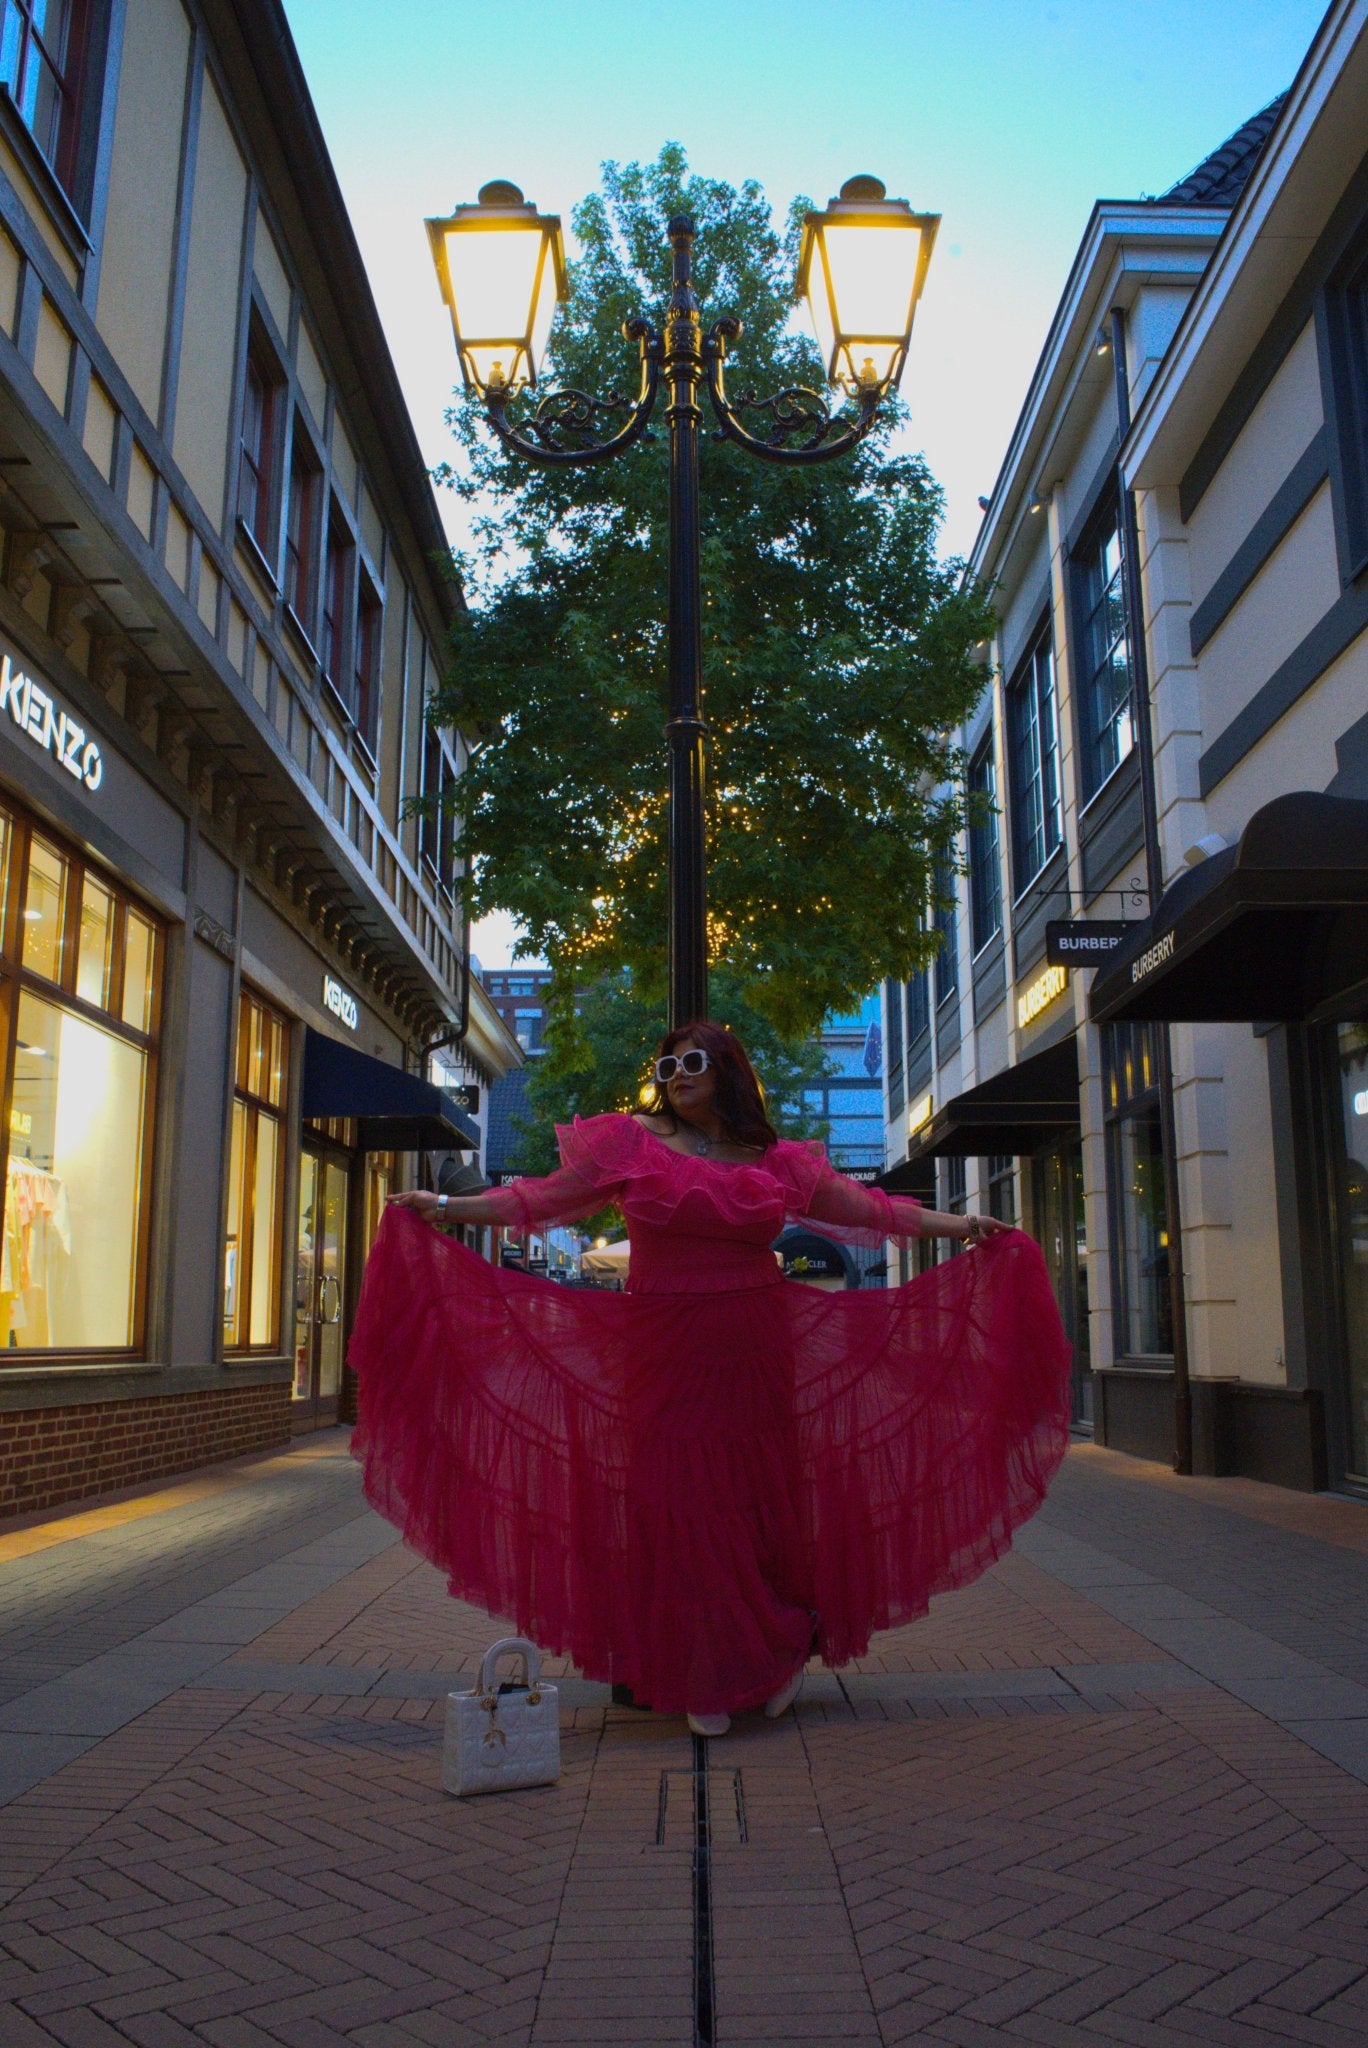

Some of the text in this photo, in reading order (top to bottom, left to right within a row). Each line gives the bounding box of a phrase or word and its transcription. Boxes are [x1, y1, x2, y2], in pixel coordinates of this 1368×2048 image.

[0, 654, 102, 790] KENZO
[1059, 937, 1123, 949] BURBER
[1132, 930, 1175, 983] BURBERRY
[324, 974, 357, 1030] KENZO
[1018, 966, 1065, 1028] BURBERRY
[786, 1260, 827, 1268] MCLER
